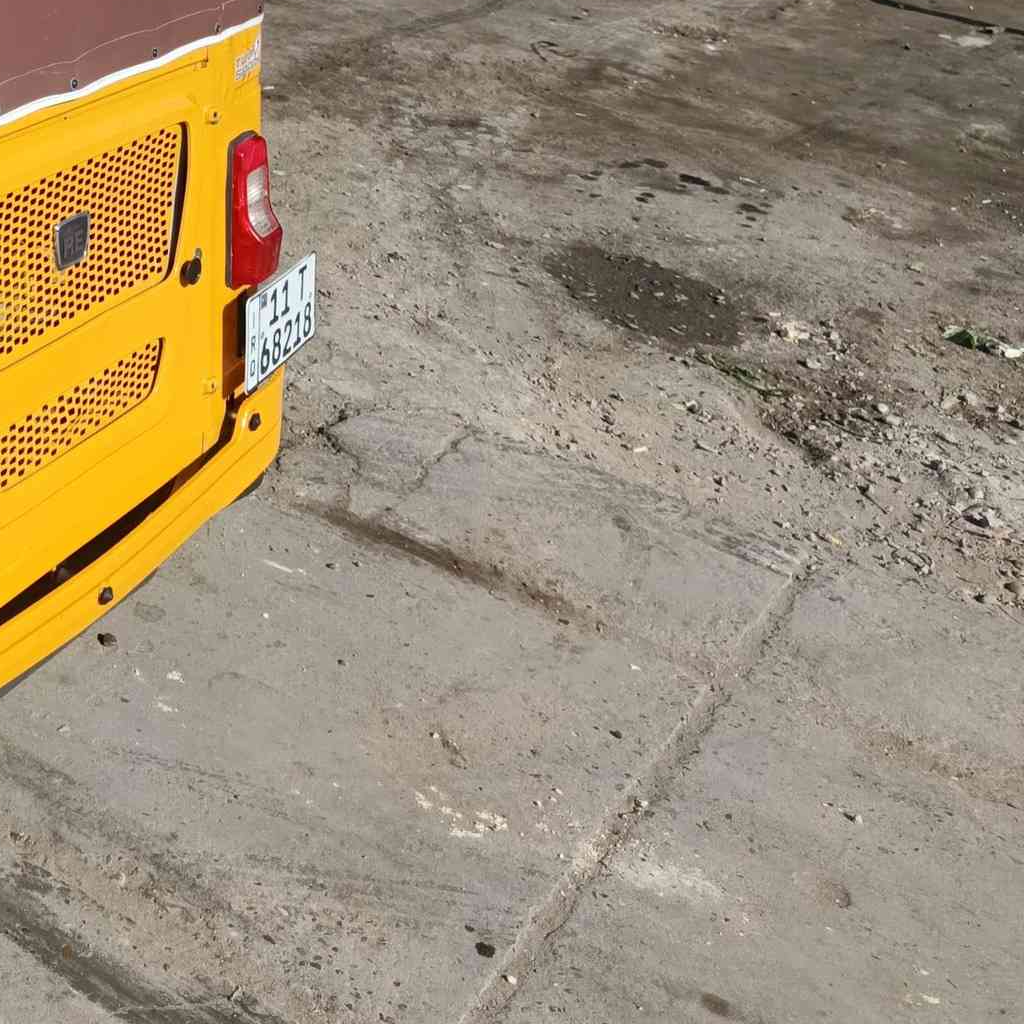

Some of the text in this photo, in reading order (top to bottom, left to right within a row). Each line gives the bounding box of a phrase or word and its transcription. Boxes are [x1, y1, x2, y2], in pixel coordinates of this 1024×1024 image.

[269, 264, 308, 326] 11 T
[260, 302, 312, 375] 68218
